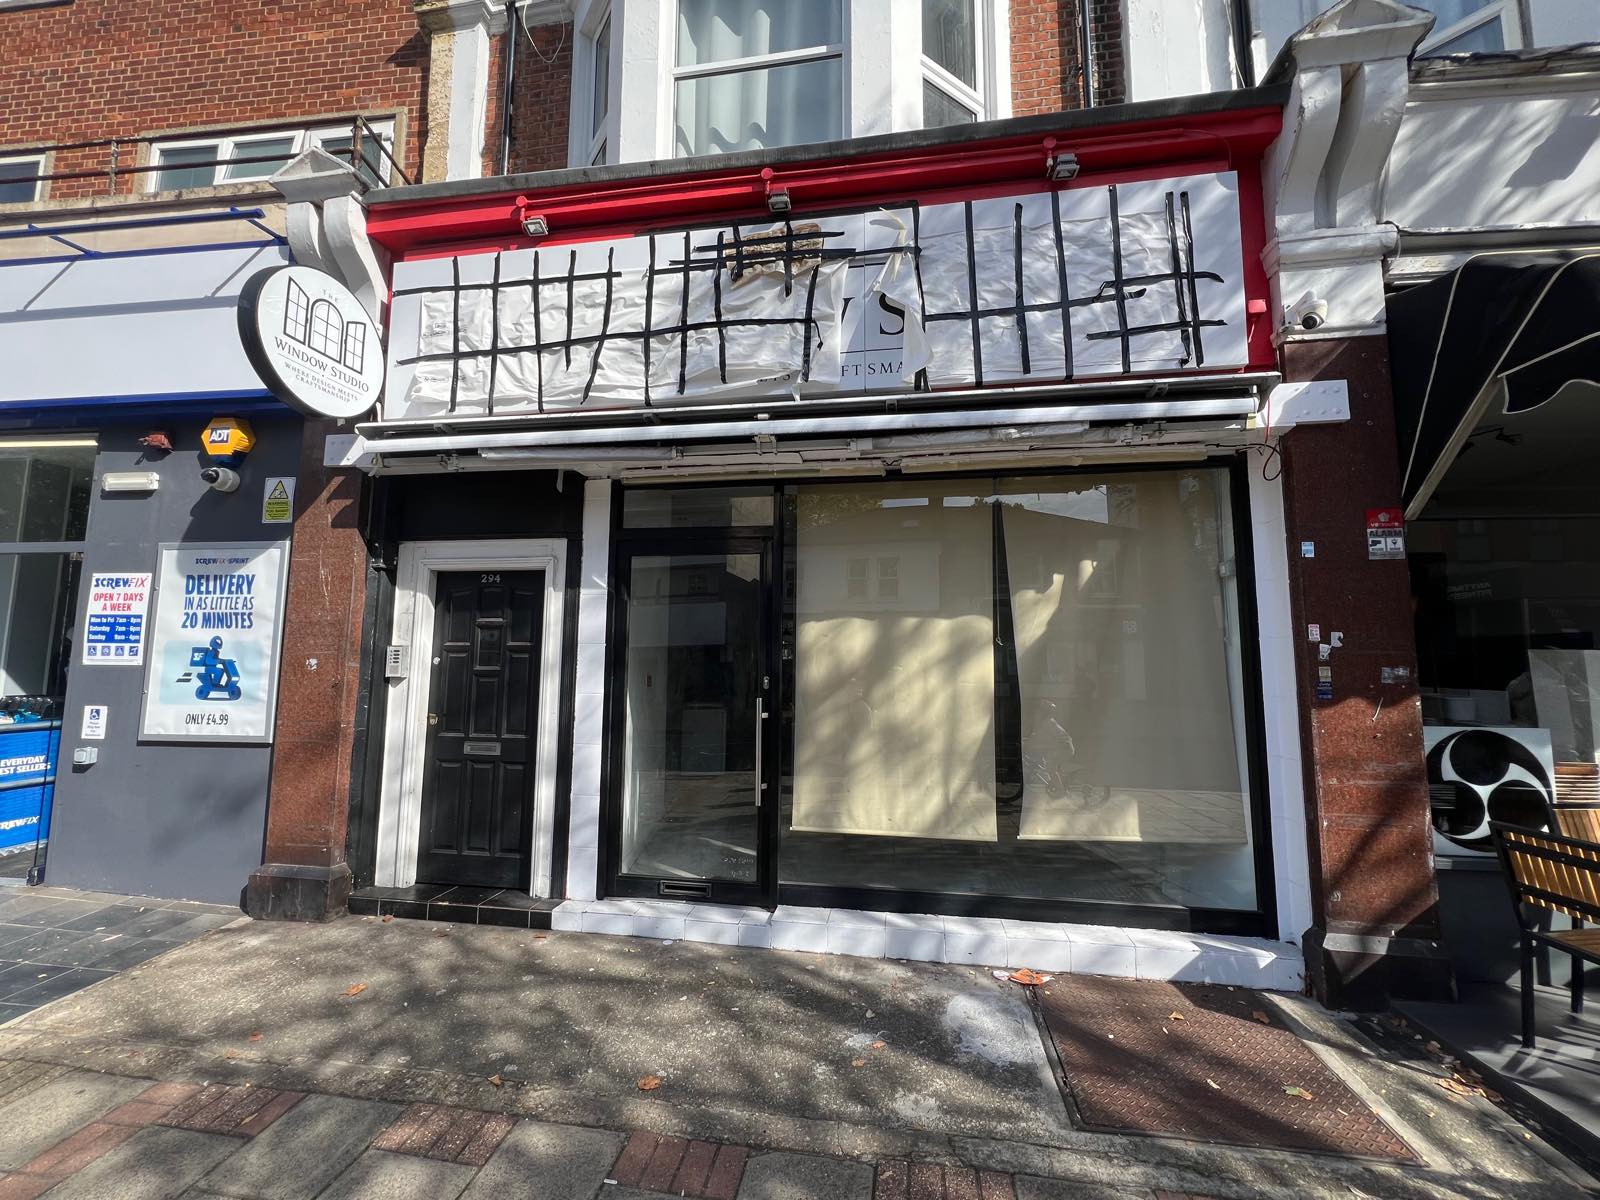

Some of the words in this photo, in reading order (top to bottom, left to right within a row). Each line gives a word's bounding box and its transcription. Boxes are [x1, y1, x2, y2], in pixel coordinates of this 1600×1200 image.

[274, 336, 328, 371] WINDOW
[331, 366, 369, 392] STUDIO
[284, 361, 309, 378] WHERE
[311, 375, 336, 390] DESIGN
[337, 388, 358, 401] MEETS
[295, 374, 351, 403] CRAFTSMANSHIP
[209, 429, 230, 441] ADT
[1369, 530, 1403, 538] ALARM
[94, 577, 147, 589] SCREWFIX
[185, 574, 256, 595] DELIVERY
[481, 574, 501, 583] 294
[93, 592, 114, 602] OPEN
[116, 592, 121, 602] 7
[123, 592, 144, 602] DAYS
[184, 596, 195, 610] IN
[196, 596, 209, 610] AS
[210, 596, 240, 610] LITTLE
[241, 596, 255, 610] AS
[102, 603, 108, 611] A
[110, 603, 132, 612] WEEK
[181, 612, 198, 628] 20
[201, 611, 253, 629] MINUTES
[185, 713, 206, 725] ONLY
[206, 713, 229, 725] £4.99
[0, 755, 46, 767] EVERYDAY
[0, 766, 16, 775] EST
[16, 762, 51, 773] SELLERS
[0, 815, 40, 830] REWFIX
